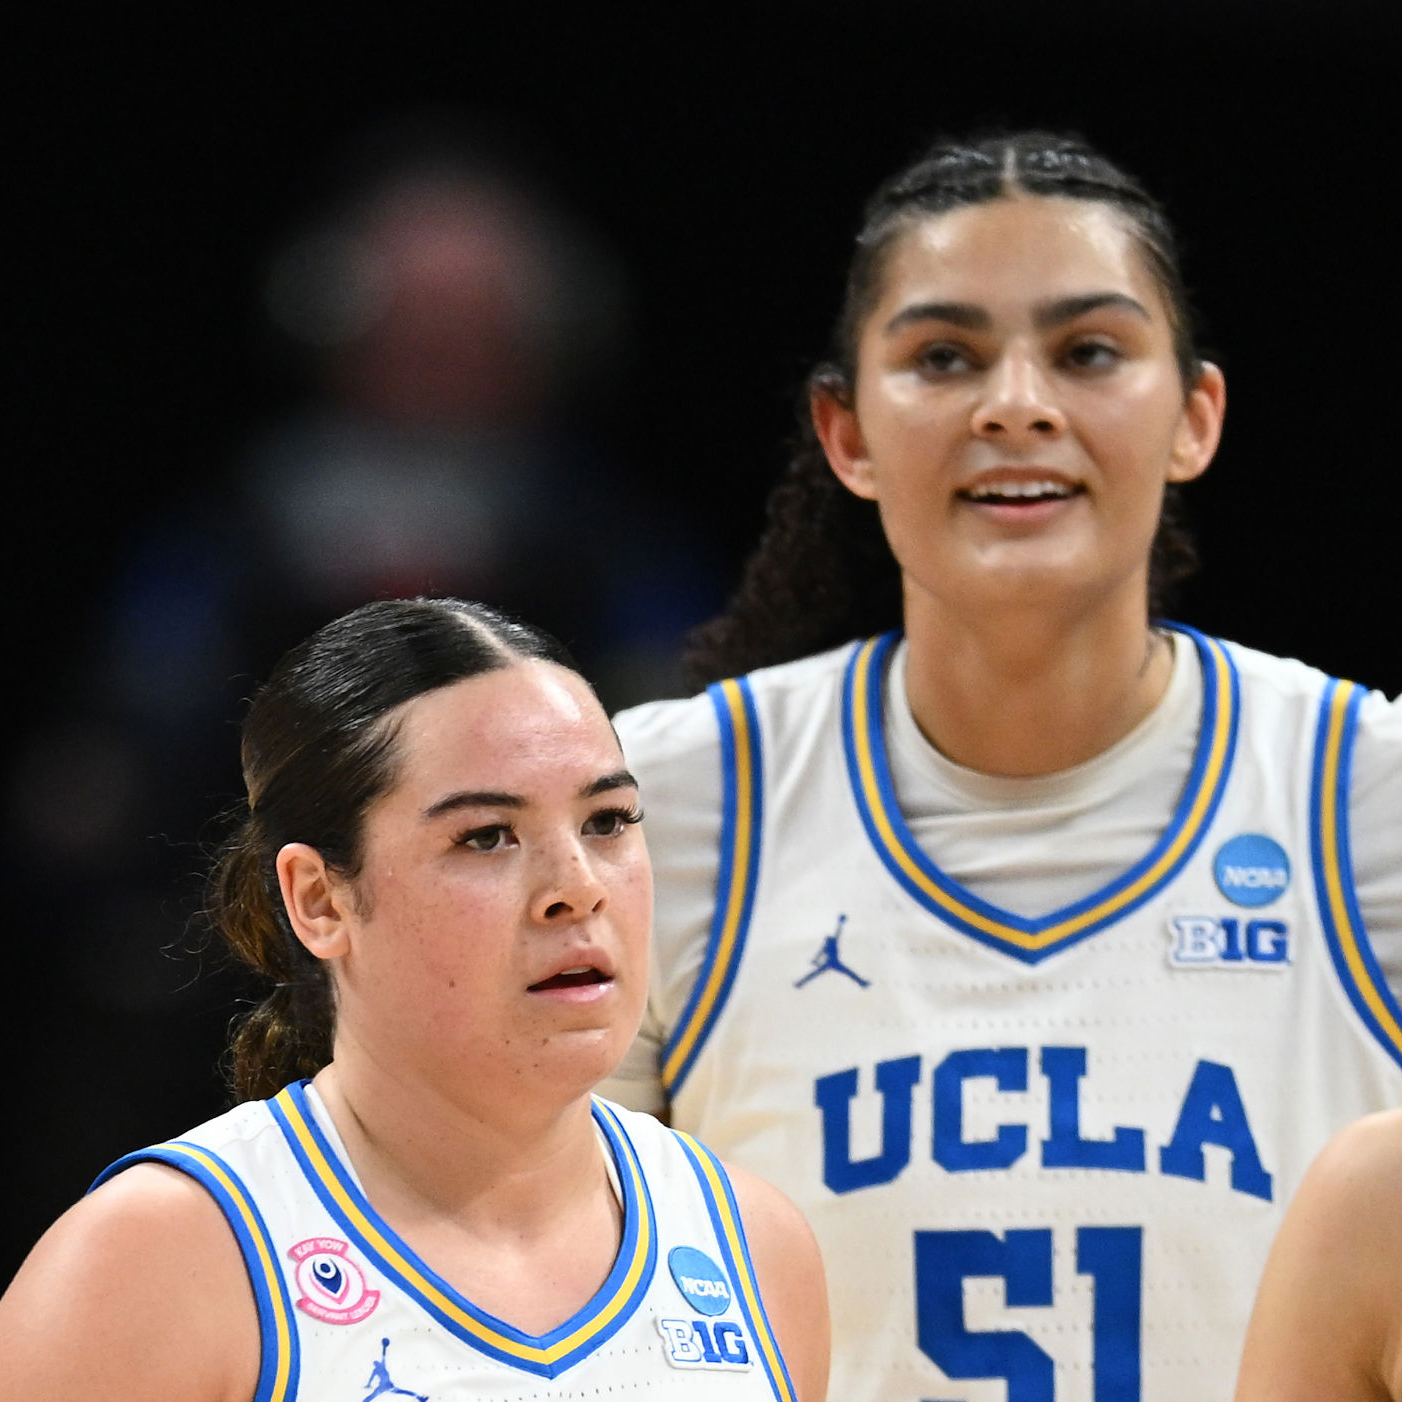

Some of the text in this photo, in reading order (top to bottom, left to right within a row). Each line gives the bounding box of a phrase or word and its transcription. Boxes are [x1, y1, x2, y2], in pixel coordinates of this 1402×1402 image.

[1223, 865, 1288, 888] NCAA
[815, 1046, 1273, 1201] UCLA
[679, 1276, 729, 1299] NCAA
